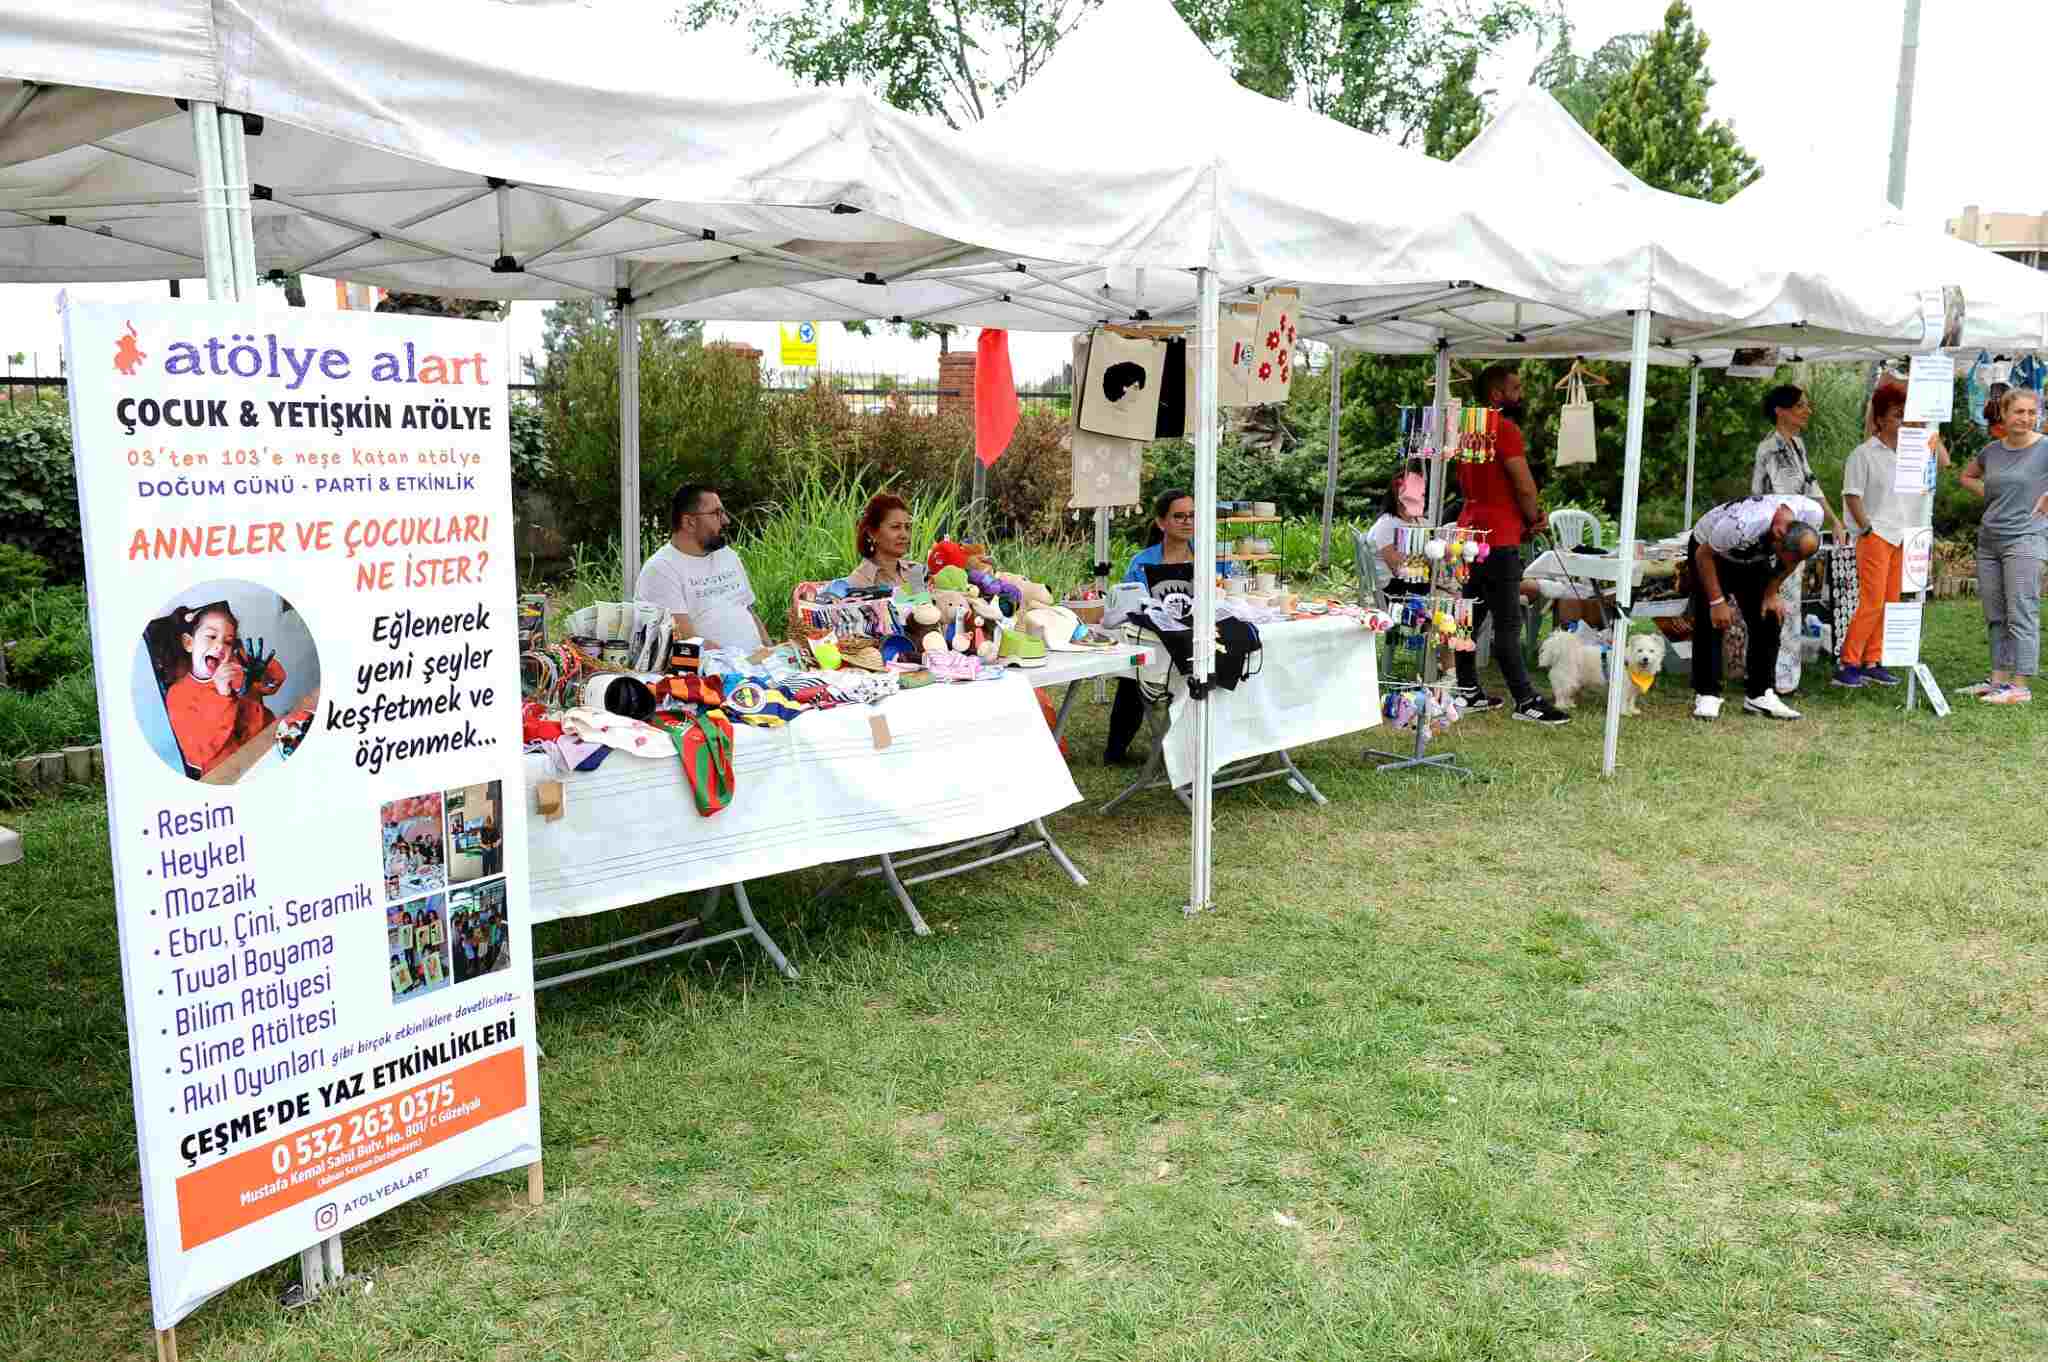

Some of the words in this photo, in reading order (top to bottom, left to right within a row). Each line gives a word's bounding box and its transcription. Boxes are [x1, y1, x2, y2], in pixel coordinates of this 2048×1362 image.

[164, 333, 351, 389] atölye
[371, 341, 488, 385] alart
[117, 398, 229, 435] ÇOCUK
[240, 403, 258, 428] &
[268, 395, 391, 435] YETİŞKİN
[401, 399, 492, 430] ATÖLYE
[296, 452, 341, 469] neşe
[418, 448, 481, 468] atölye
[138, 474, 225, 497] DOĞUM
[234, 475, 294, 494] GÜNÜ
[316, 473, 372, 493] PARTİ
[379, 477, 390, 491] &
[397, 472, 475, 491] ETKİNLİK
[128, 522, 288, 560] ANNELER
[295, 520, 334, 551] VE
[343, 514, 489, 558] ÇOCUKLARI
[357, 561, 394, 592] NE
[405, 551, 489, 587] İSTER?
[373, 602, 490, 649] Eğlenerek
[358, 653, 413, 694] yeni
[425, 647, 493, 685] şeyler
[326, 684, 461, 734] keşfetmek
[470, 686, 494, 709] ve
[355, 722, 497, 775] öğrenmek...
[158, 802, 235, 839] Resim
[161, 835, 246, 880] Heykel
[165, 873, 257, 919] Mozaik
[234, 906, 280, 948] Çini,
[286, 882, 373, 927] Seramik
[244, 934, 334, 979] Boyama
[175, 1001, 234, 1037] Bilim
[242, 965, 331, 1016] Atölyesi
[179, 1031, 245, 1075] Slime
[251, 1000, 337, 1052] Atöltesi
[318, 1072, 366, 1109] YAZ
[372, 1012, 517, 1089] ETKİNLİKLERİ
[332, 1045, 354, 1067] gibi
[358, 1032, 392, 1054] birçok
[395, 1012, 452, 1040] etkinliklere
[183, 1078, 226, 1113] Akıl
[235, 1048, 325, 1096] Oyunları
[272, 1143, 290, 1175] 0
[295, 1122, 343, 1166] 532
[348, 1101, 395, 1144] 263
[399, 1078, 455, 1123] 0375
[240, 1178, 289, 1206] Mustafa
[289, 1160, 326, 1186] Kemal
[344, 1167, 430, 1214] ATOLYEALART
